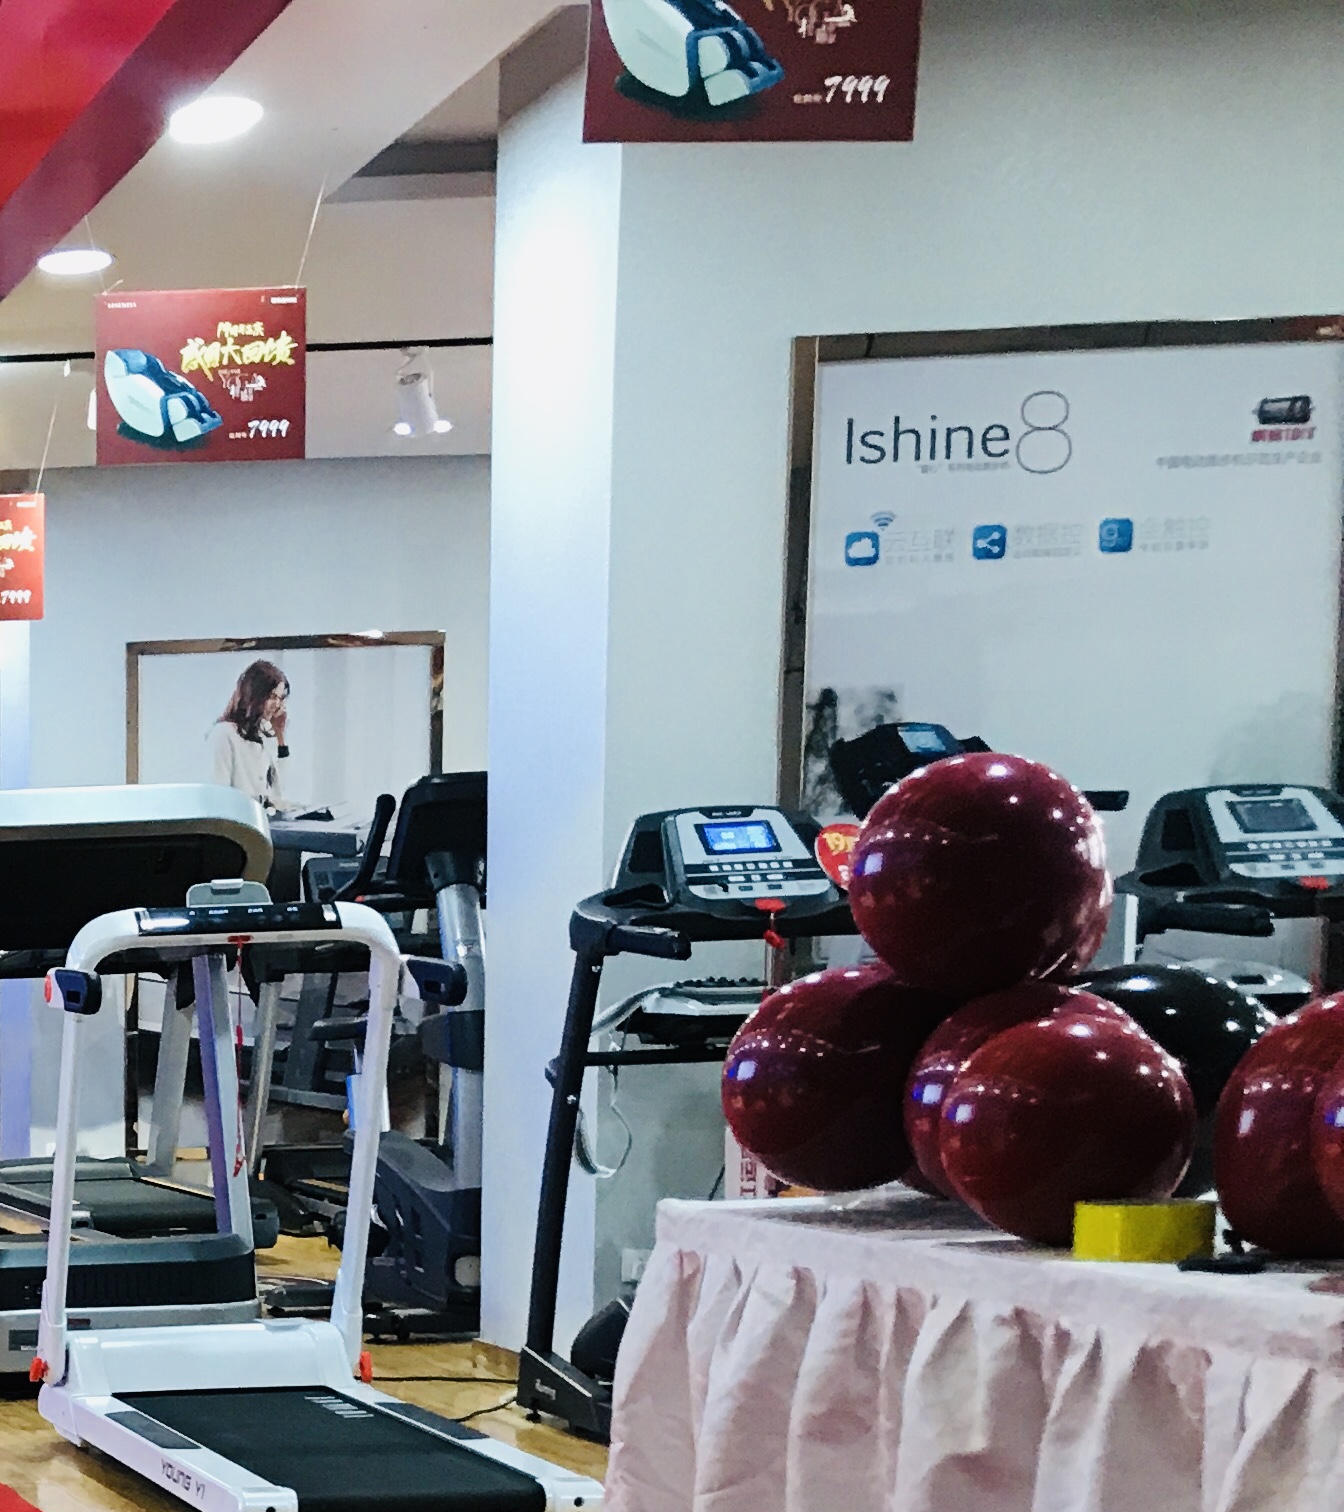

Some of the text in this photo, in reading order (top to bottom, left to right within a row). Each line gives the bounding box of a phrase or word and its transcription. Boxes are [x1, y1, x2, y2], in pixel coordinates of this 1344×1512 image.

[824, 75, 890, 103] 7999
[248, 419, 290, 438] 7999
[0, 590, 31, 604] 7999
